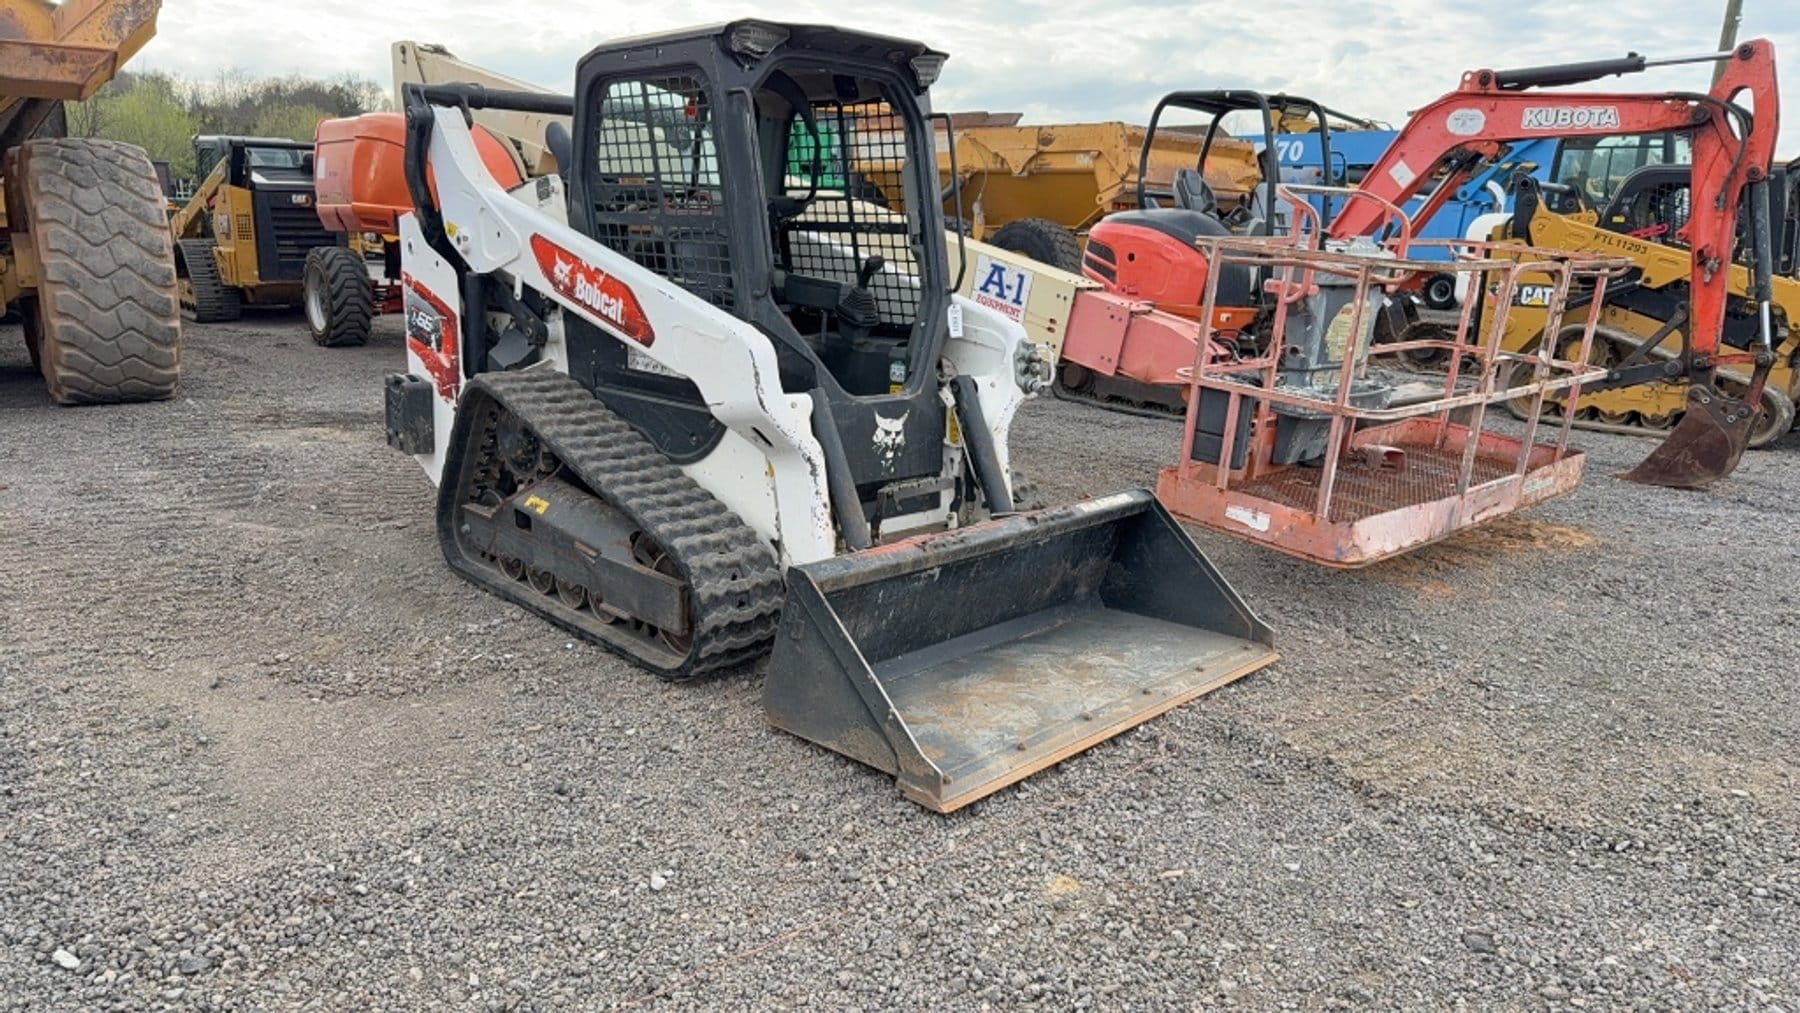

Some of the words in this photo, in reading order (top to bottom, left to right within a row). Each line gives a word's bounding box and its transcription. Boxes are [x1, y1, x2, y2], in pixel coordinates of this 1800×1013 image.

[1524, 107, 1618, 128] KUBOTA
[980, 263, 1025, 305] A-1
[1521, 286, 1554, 305] CAT
[575, 272, 624, 325] Bobcat
[975, 293, 1021, 318] EQUIPMENT
